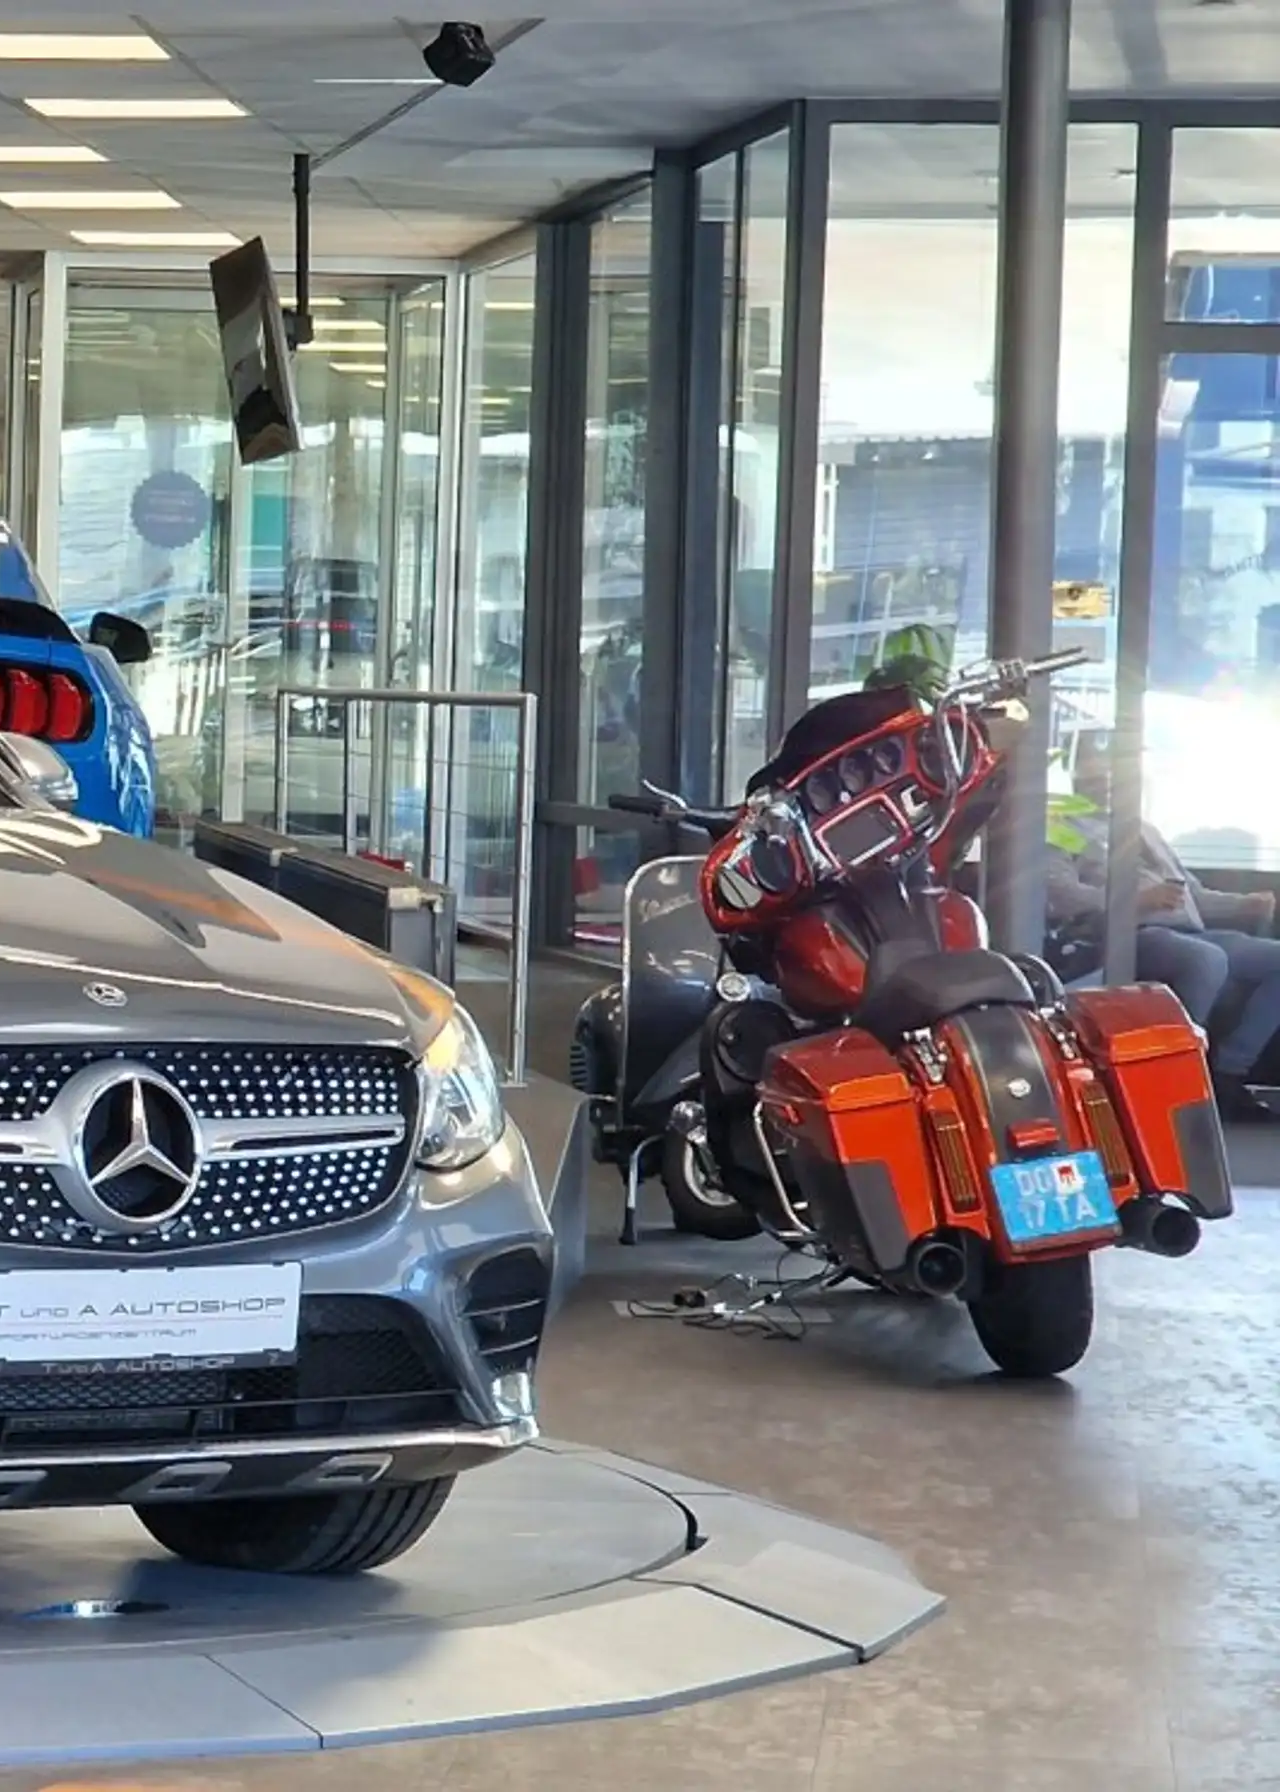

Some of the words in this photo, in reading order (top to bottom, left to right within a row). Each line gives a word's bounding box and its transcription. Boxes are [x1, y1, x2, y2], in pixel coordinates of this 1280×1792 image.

[78, 1304, 98, 1316] A
[110, 1297, 286, 1316] AUTOSHOP
[115, 1356, 236, 1371] AUTOSHOP
